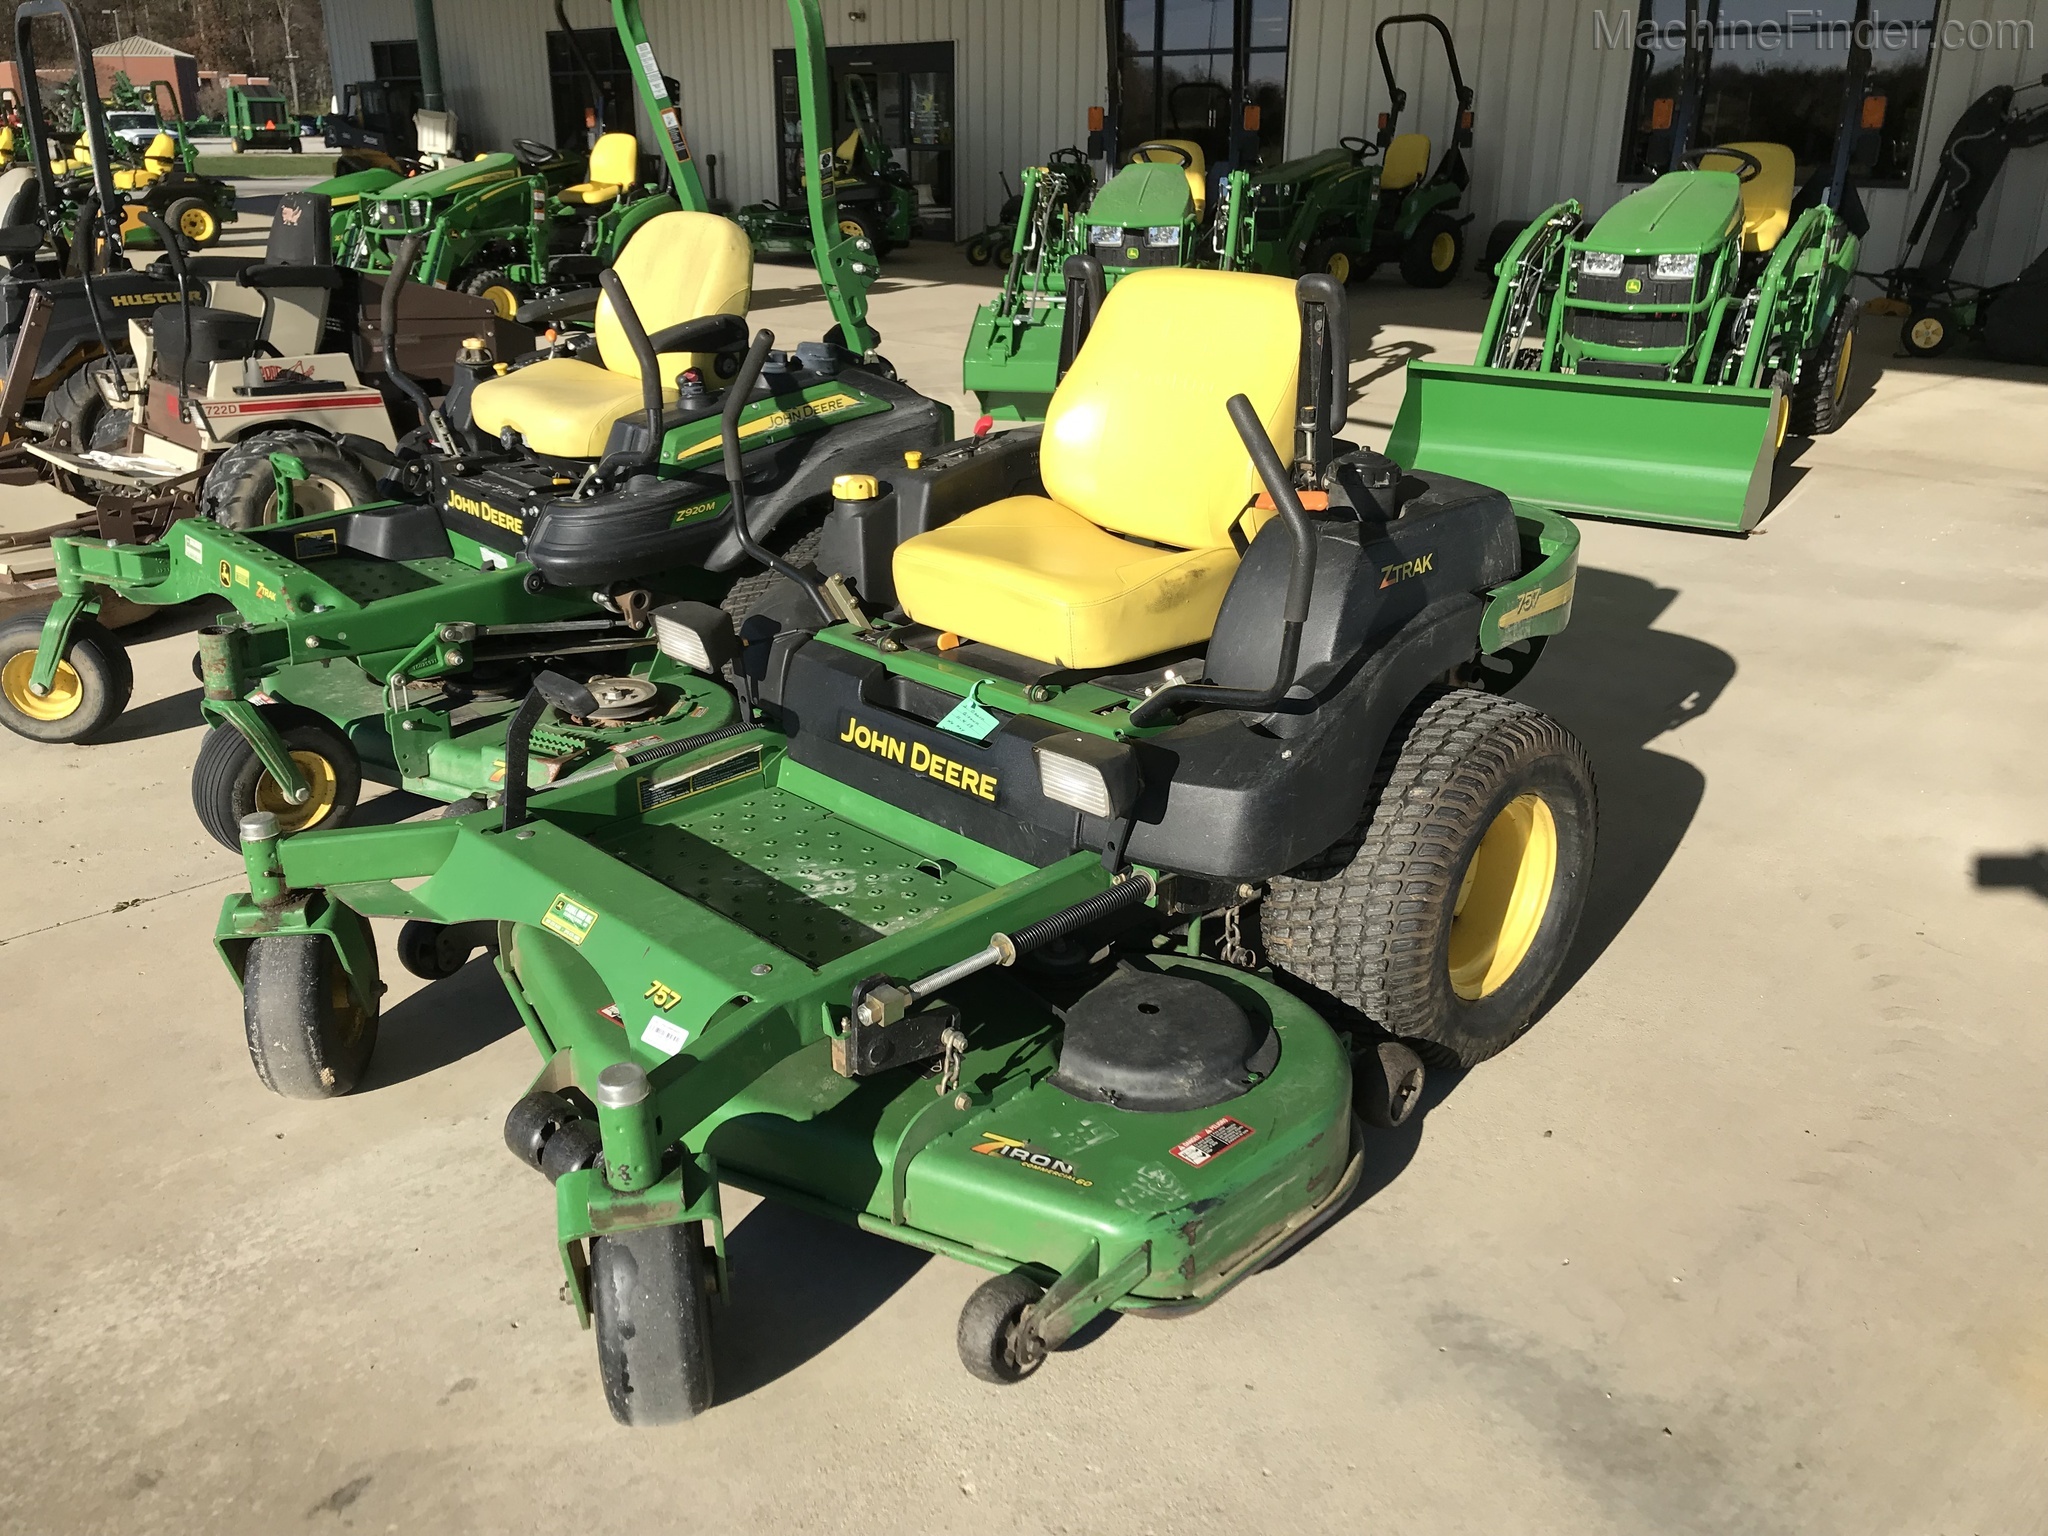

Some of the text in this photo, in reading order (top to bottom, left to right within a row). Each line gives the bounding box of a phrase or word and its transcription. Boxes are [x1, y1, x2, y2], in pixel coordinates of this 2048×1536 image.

[205, 404, 237, 416] 722D
[767, 398, 844, 429] JOHN DEERE
[448, 489, 524, 536] JOHN DEERE
[1517, 587, 1542, 615] 757
[840, 717, 907, 765] JOHN
[910, 741, 998, 802] DEERE
[644, 979, 682, 1013] 757
